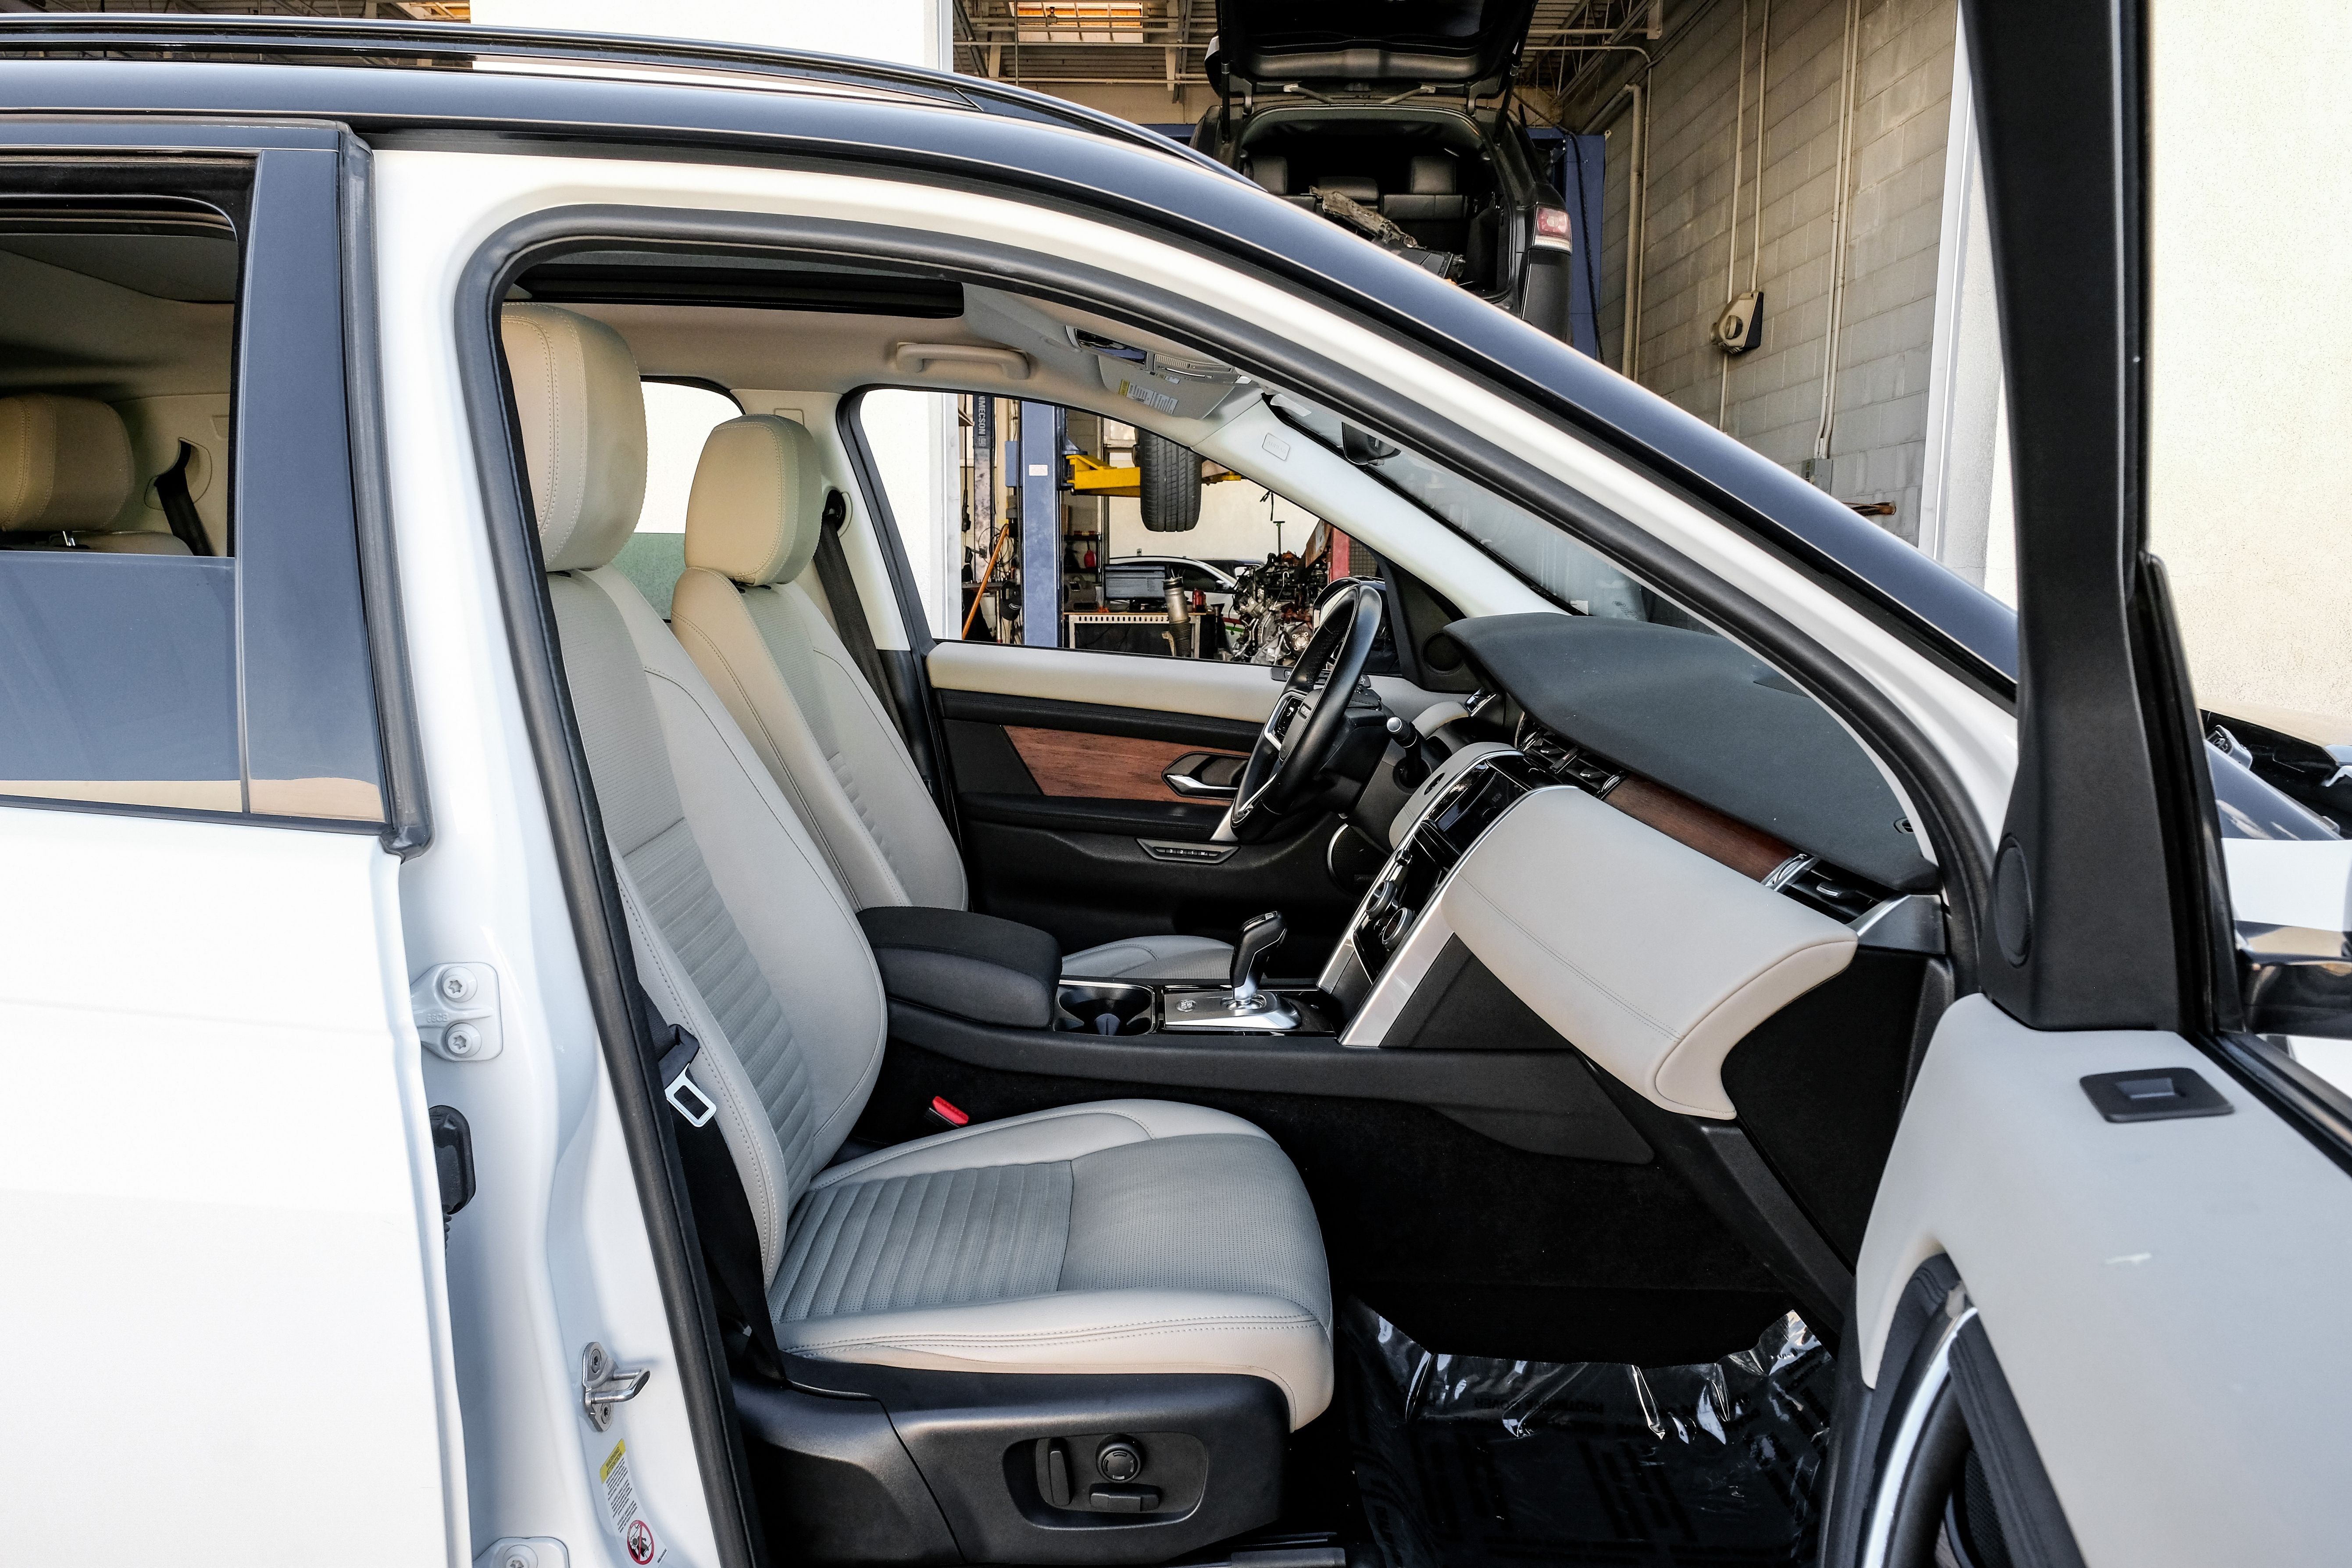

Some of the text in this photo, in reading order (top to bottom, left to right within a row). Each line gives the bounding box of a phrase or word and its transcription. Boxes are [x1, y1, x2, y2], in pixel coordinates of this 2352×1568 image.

[1267, 441, 1286, 454] AIRBAG
[606, 1447, 620, 1468] WARNING
[607, 1451, 622, 1476] ATTENTION
